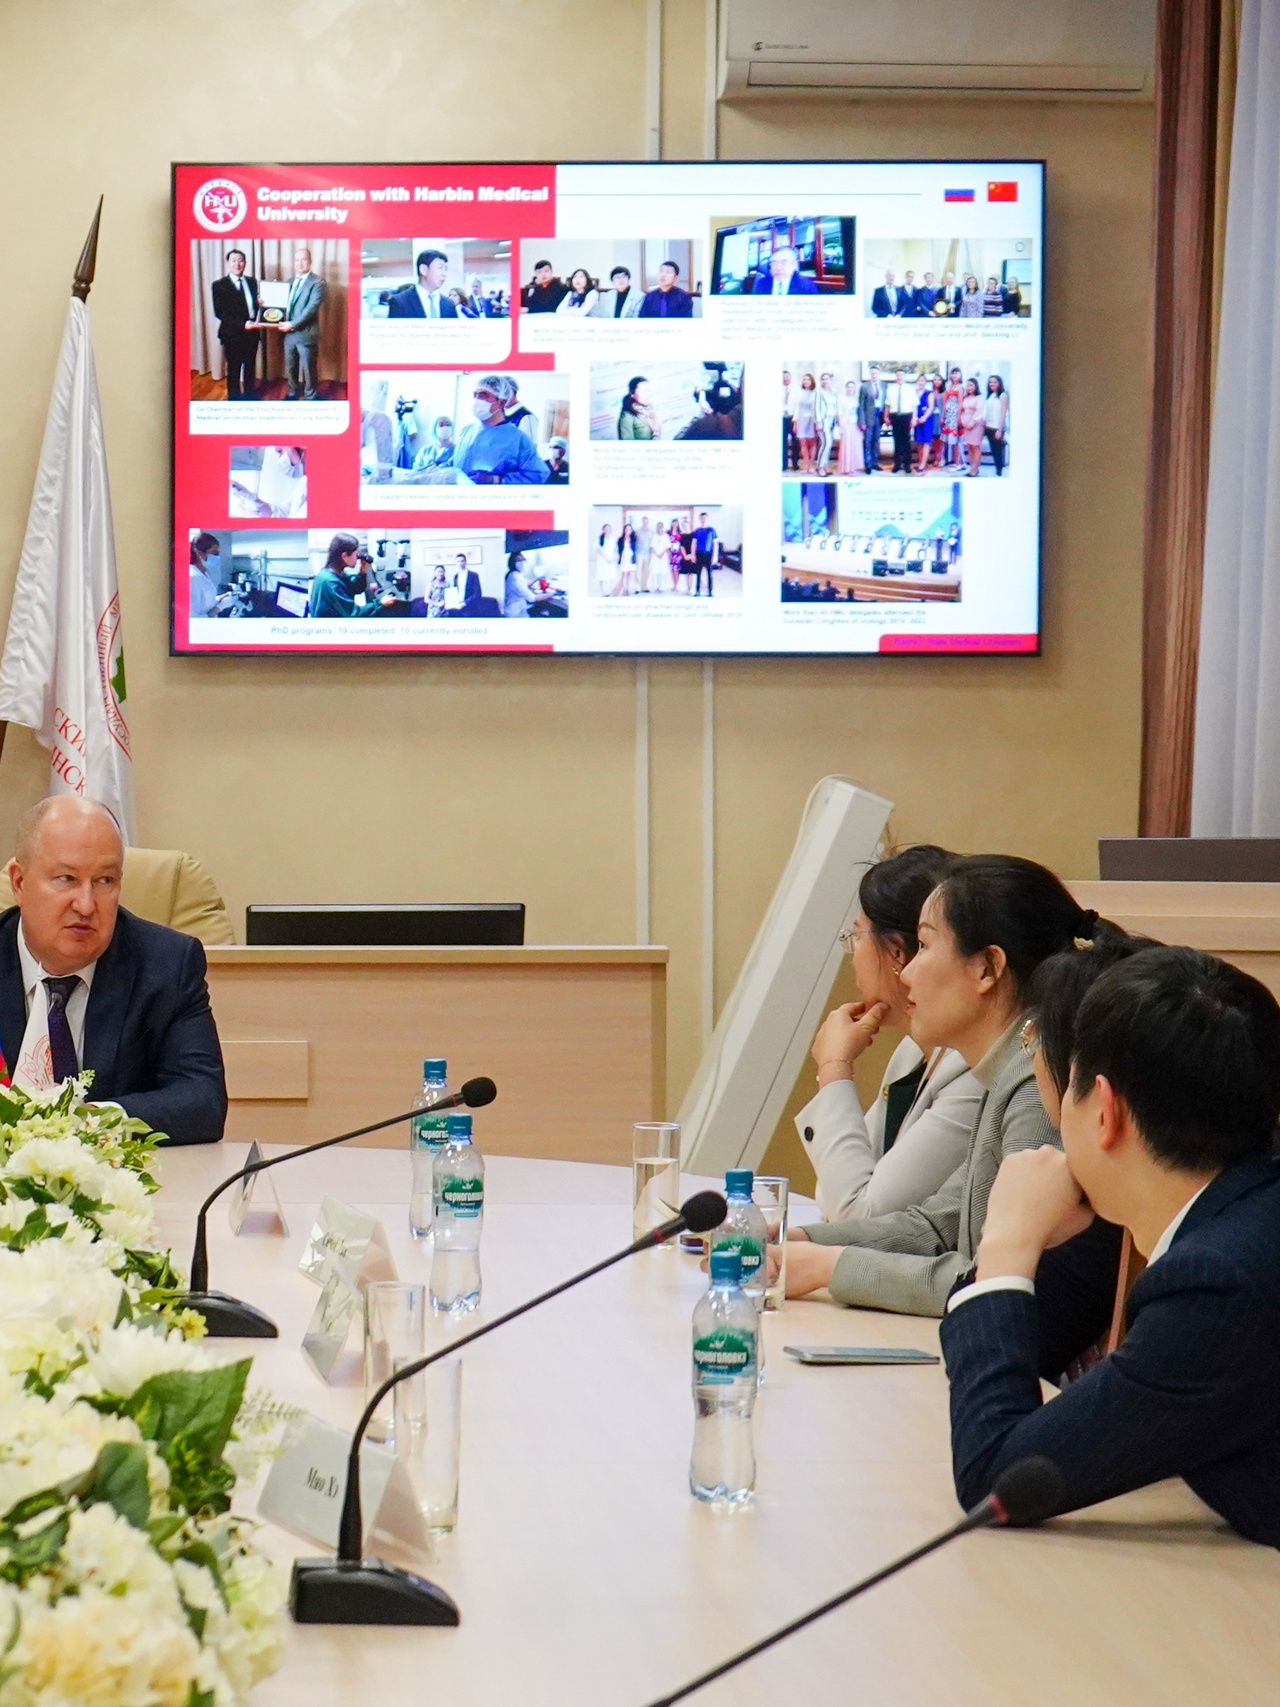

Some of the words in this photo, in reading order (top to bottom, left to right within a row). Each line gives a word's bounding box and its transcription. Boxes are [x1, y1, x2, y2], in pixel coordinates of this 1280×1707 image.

[257, 187, 366, 204] Cooperation
[370, 187, 410, 201] with
[414, 187, 474, 201] Harbin
[478, 187, 549, 201] Medical
[257, 206, 348, 223] University
[271, 626, 288, 635] PhD
[411, 626, 450, 637] currently
[452, 626, 488, 635] enrolled
[51, 746, 87, 797] НСК
